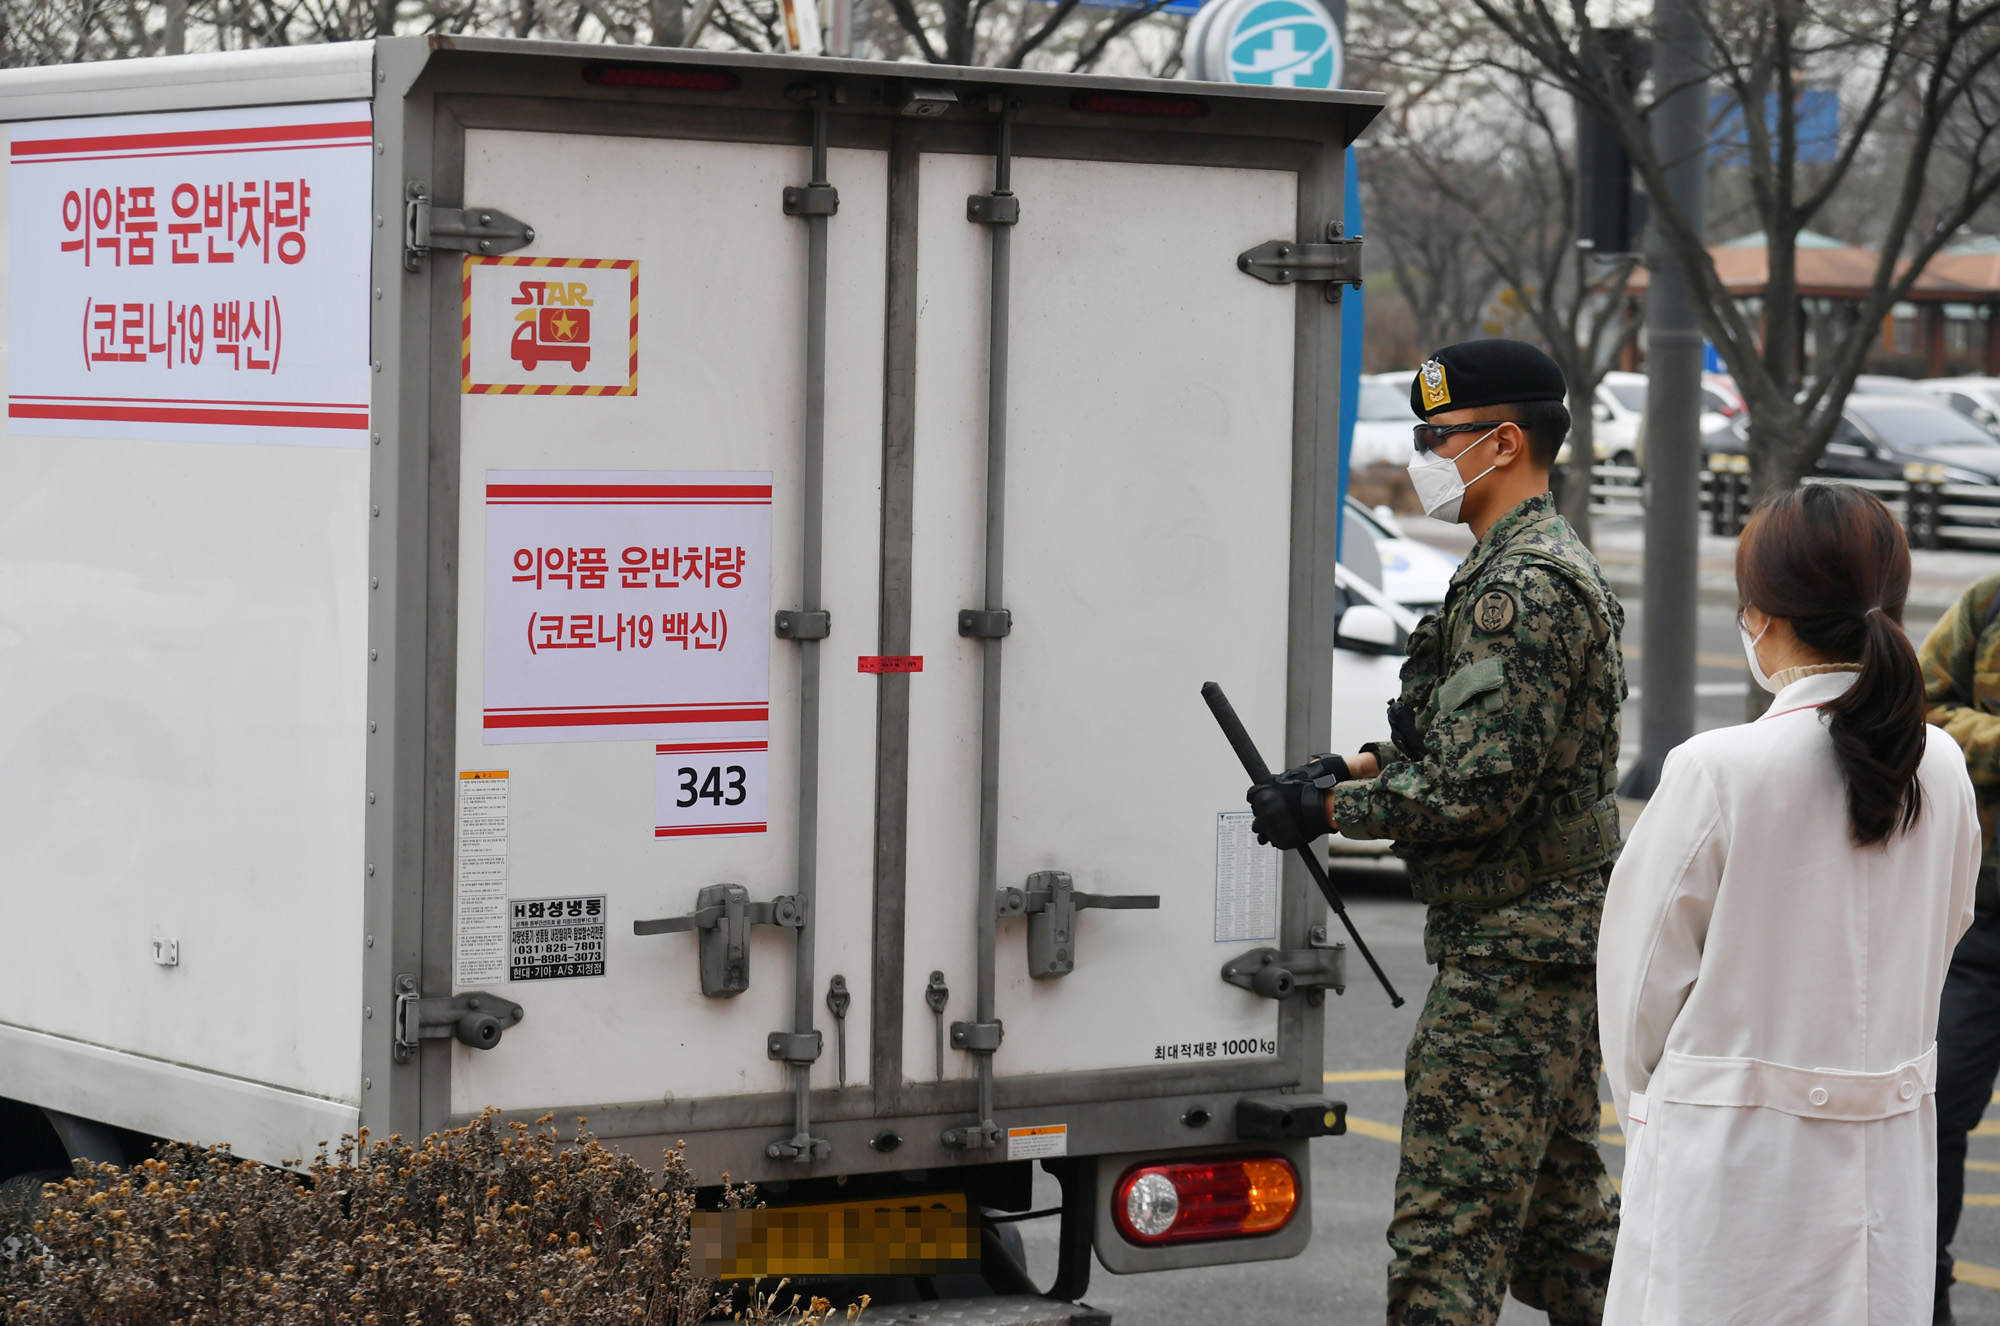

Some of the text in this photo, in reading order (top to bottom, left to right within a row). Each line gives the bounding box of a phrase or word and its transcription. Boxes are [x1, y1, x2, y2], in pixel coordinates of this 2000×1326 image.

[60, 178, 311, 268] 의약품 운반차량
[510, 280, 594, 307] STAR
[82, 295, 282, 375] (코로나19 백신)
[512, 545, 746, 590] 의약품 운반차량
[527, 609, 729, 655] (코로나19 백신)
[675, 765, 747, 807] 343
[528, 899, 601, 918] 화성냉동
[514, 941, 602, 955] (031)826-7801
[514, 952, 601, 965] 010-8984-3073
[576, 963, 602, 975] 지정점
[1154, 1038, 1275, 1060] 최대적재량 1000 kg
